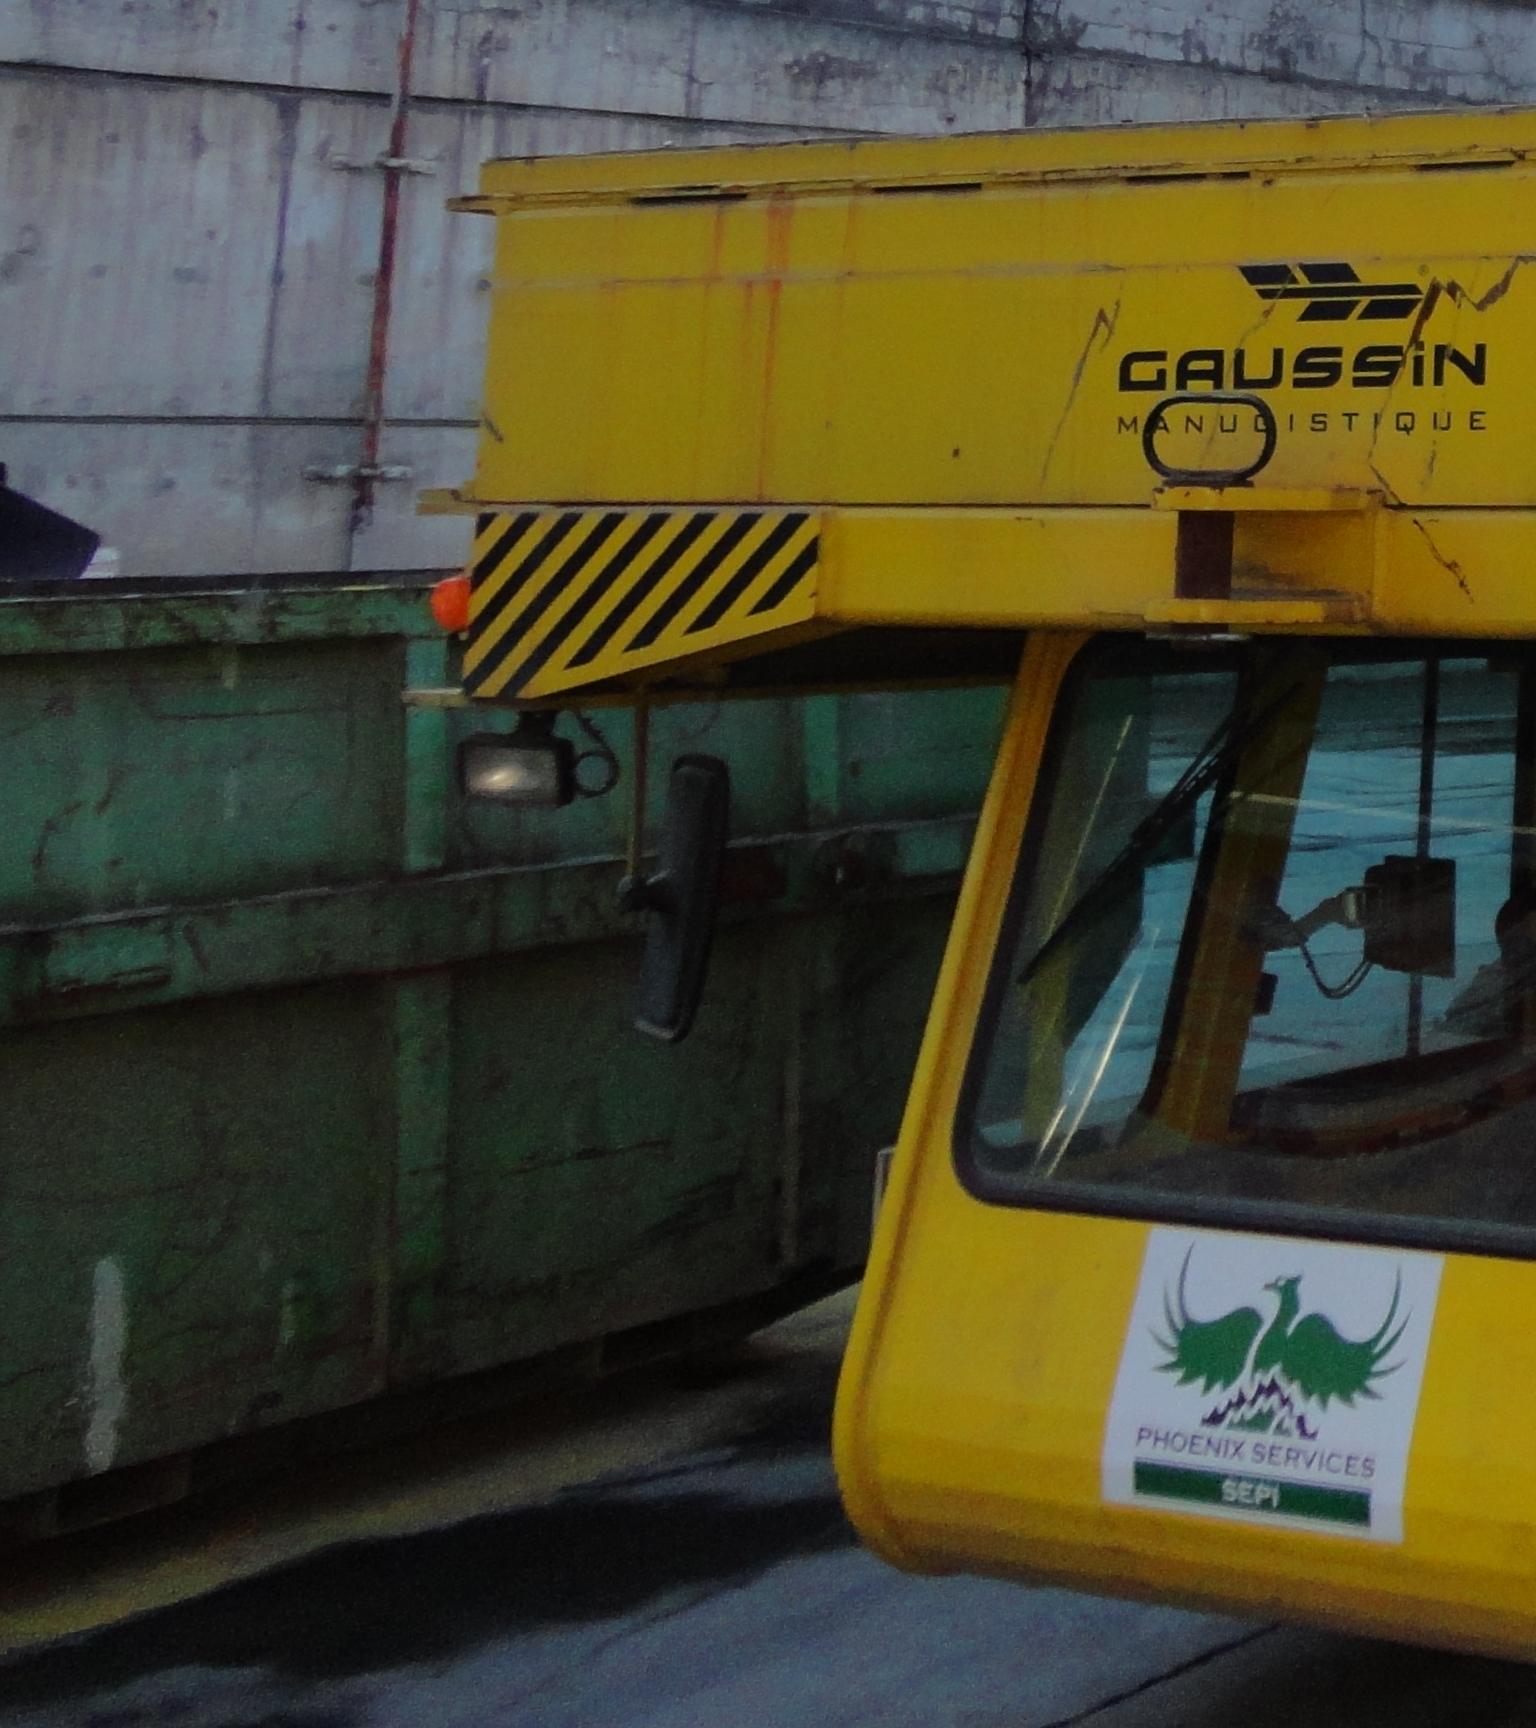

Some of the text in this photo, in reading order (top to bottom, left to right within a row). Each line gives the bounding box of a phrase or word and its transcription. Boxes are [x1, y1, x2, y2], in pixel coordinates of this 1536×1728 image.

[1135, 1427, 1376, 1479] PHOENIX SERVICES
[1221, 1478, 1280, 1510] SEPI
